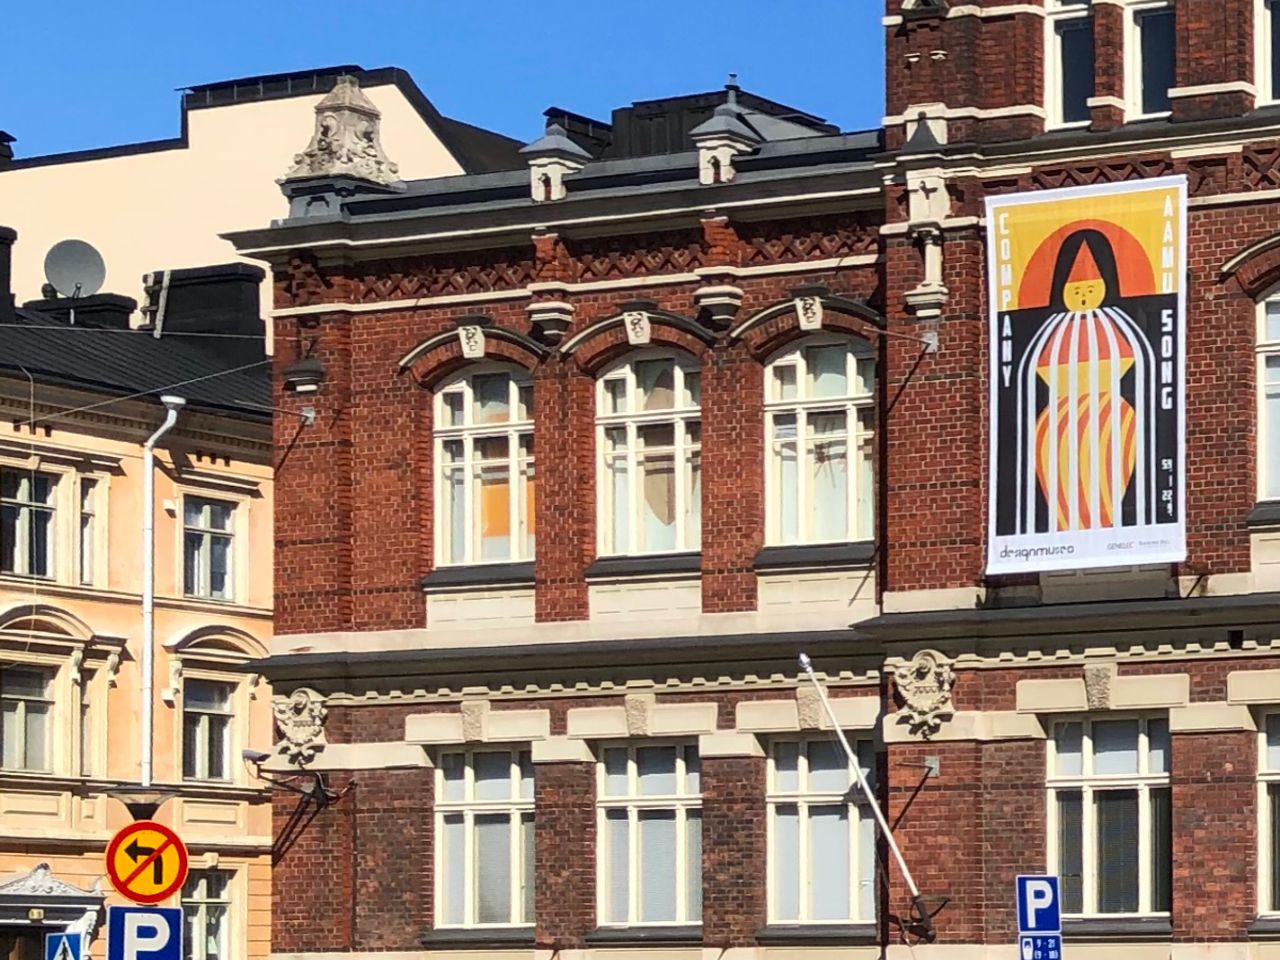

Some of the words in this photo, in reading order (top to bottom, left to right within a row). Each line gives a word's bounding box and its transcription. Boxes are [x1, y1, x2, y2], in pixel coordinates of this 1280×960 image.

[1161, 194, 1174, 294] AAMU
[999, 212, 1013, 388] COMPANY
[1160, 309, 1174, 410] SONG
[123, 912, 171, 960] P
[1025, 880, 1053, 928] P
